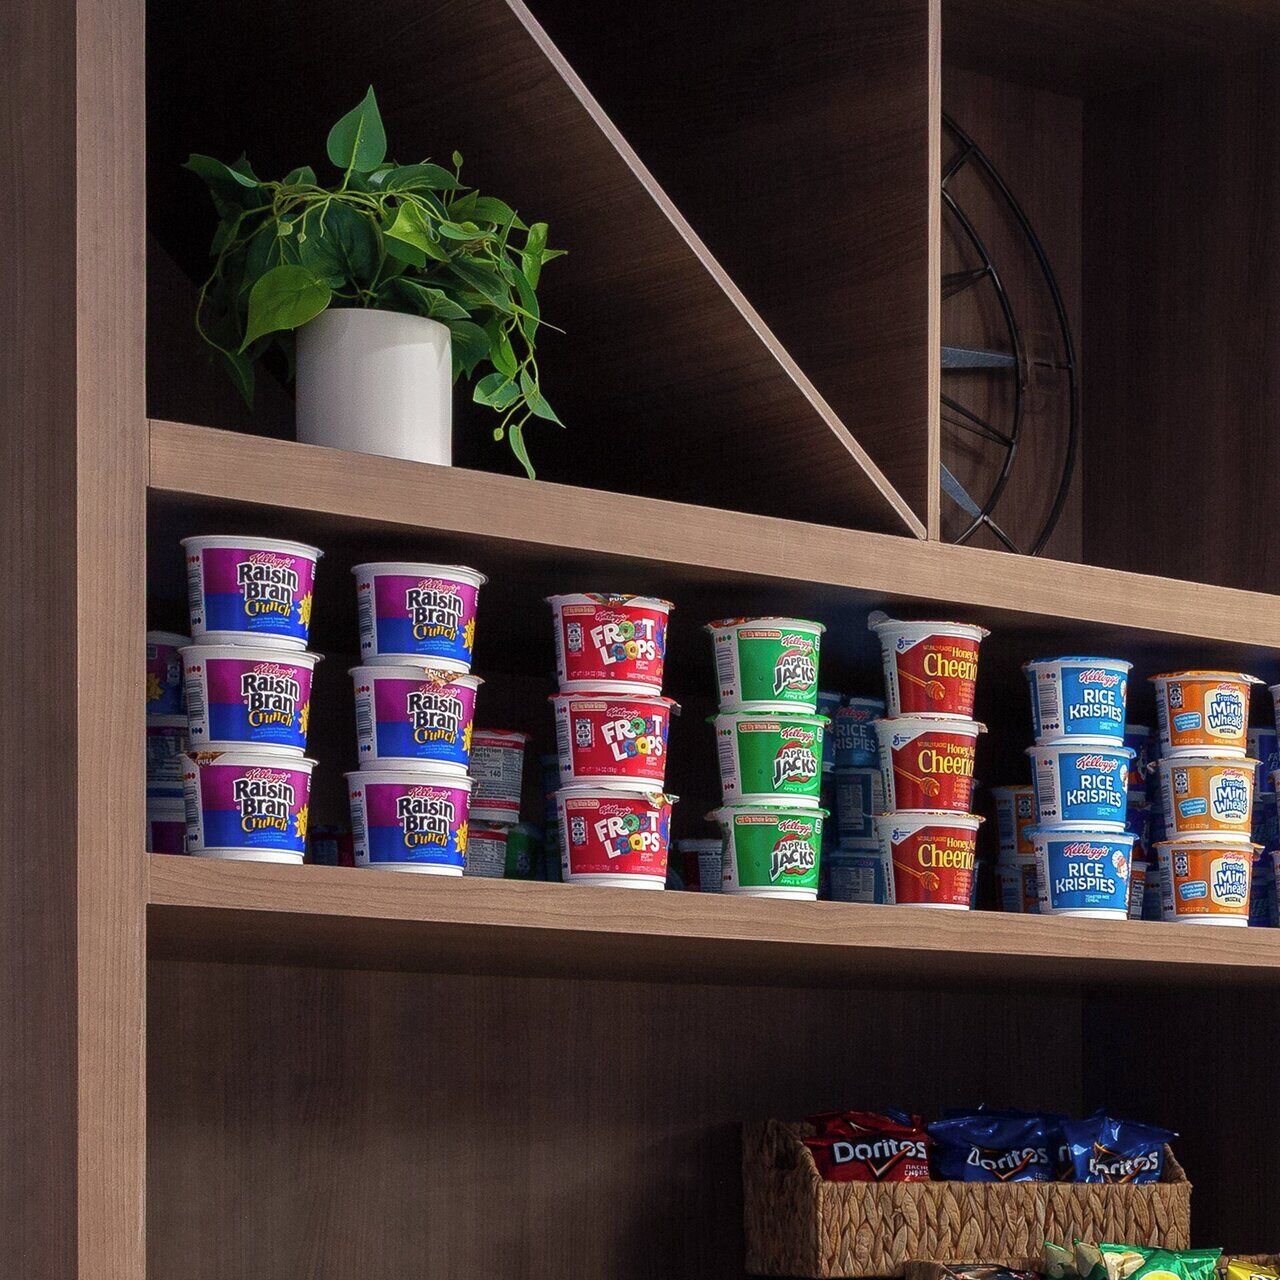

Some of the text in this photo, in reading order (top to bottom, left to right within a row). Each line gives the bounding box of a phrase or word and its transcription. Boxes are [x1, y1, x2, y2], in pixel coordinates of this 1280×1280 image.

[250, 552, 292, 567] Kellogg's
[238, 562, 298, 591] Raisin
[245, 582, 292, 604] Bran
[419, 579, 457, 593] Kellogg's
[244, 600, 291, 616] Crunch
[406, 588, 463, 616] Raisin
[413, 607, 458, 629] Bran
[413, 624, 456, 641] Crunch
[590, 618, 654, 648] FROOT
[600, 639, 655, 665] LOOPS
[254, 663, 294, 678] Kellogg's
[924, 653, 978, 681] Cheerio
[242, 673, 299, 700] Raisin
[773, 665, 815, 695] JACKS
[249, 692, 294, 715] Bran
[408, 692, 463, 720] Raisin
[1083, 689, 1115, 705] RICE
[1216, 693, 1239, 702] Frosted
[1069, 704, 1122, 722] KRISPIES
[1211, 701, 1243, 717] Mini
[249, 710, 292, 727] Crunch
[413, 710, 458, 733] Bran
[1208, 714, 1243, 730] Wheats
[414, 728, 456, 744] Crunch
[601, 715, 662, 744] FROOT
[836, 724, 867, 738] RICE
[611, 736, 663, 761] LOOPS
[783, 749, 811, 759] APPLE
[832, 737, 876, 753] RISPIES
[918, 750, 974, 777] Cheerio
[246, 768, 288, 782] Kellogg's
[773, 758, 817, 789] JACKS
[1081, 775, 1114, 790] RICE
[1221, 778, 1244, 787] Frosted
[233, 778, 294, 805] Raisin
[408, 786, 449, 800] Kellogg's
[1067, 789, 1121, 807] KRISPIES
[1217, 786, 1247, 803] Mini
[241, 798, 289, 819] Bran
[396, 796, 454, 822] Raisin
[1213, 798, 1247, 814] Wheats
[241, 816, 287, 832] Crunch
[404, 814, 449, 835] Bran
[594, 811, 659, 842] FROOT
[404, 832, 448, 848] Crunch
[604, 832, 660, 859] LOOPS
[780, 841, 808, 852] APPLE
[918, 844, 974, 870] Cheerio
[1063, 842, 1109, 860] Kellogg's
[770, 851, 815, 881] JACKS
[1068, 863, 1104, 877] RICE
[1222, 862, 1243, 871] Frosted
[1055, 877, 1116, 894] KRISPIES
[1217, 869, 1246, 886] Mini
[1214, 882, 1247, 898] Wheats
[834, 1138, 927, 1168] Doritos
[967, 1146, 1048, 1172] Doritos
